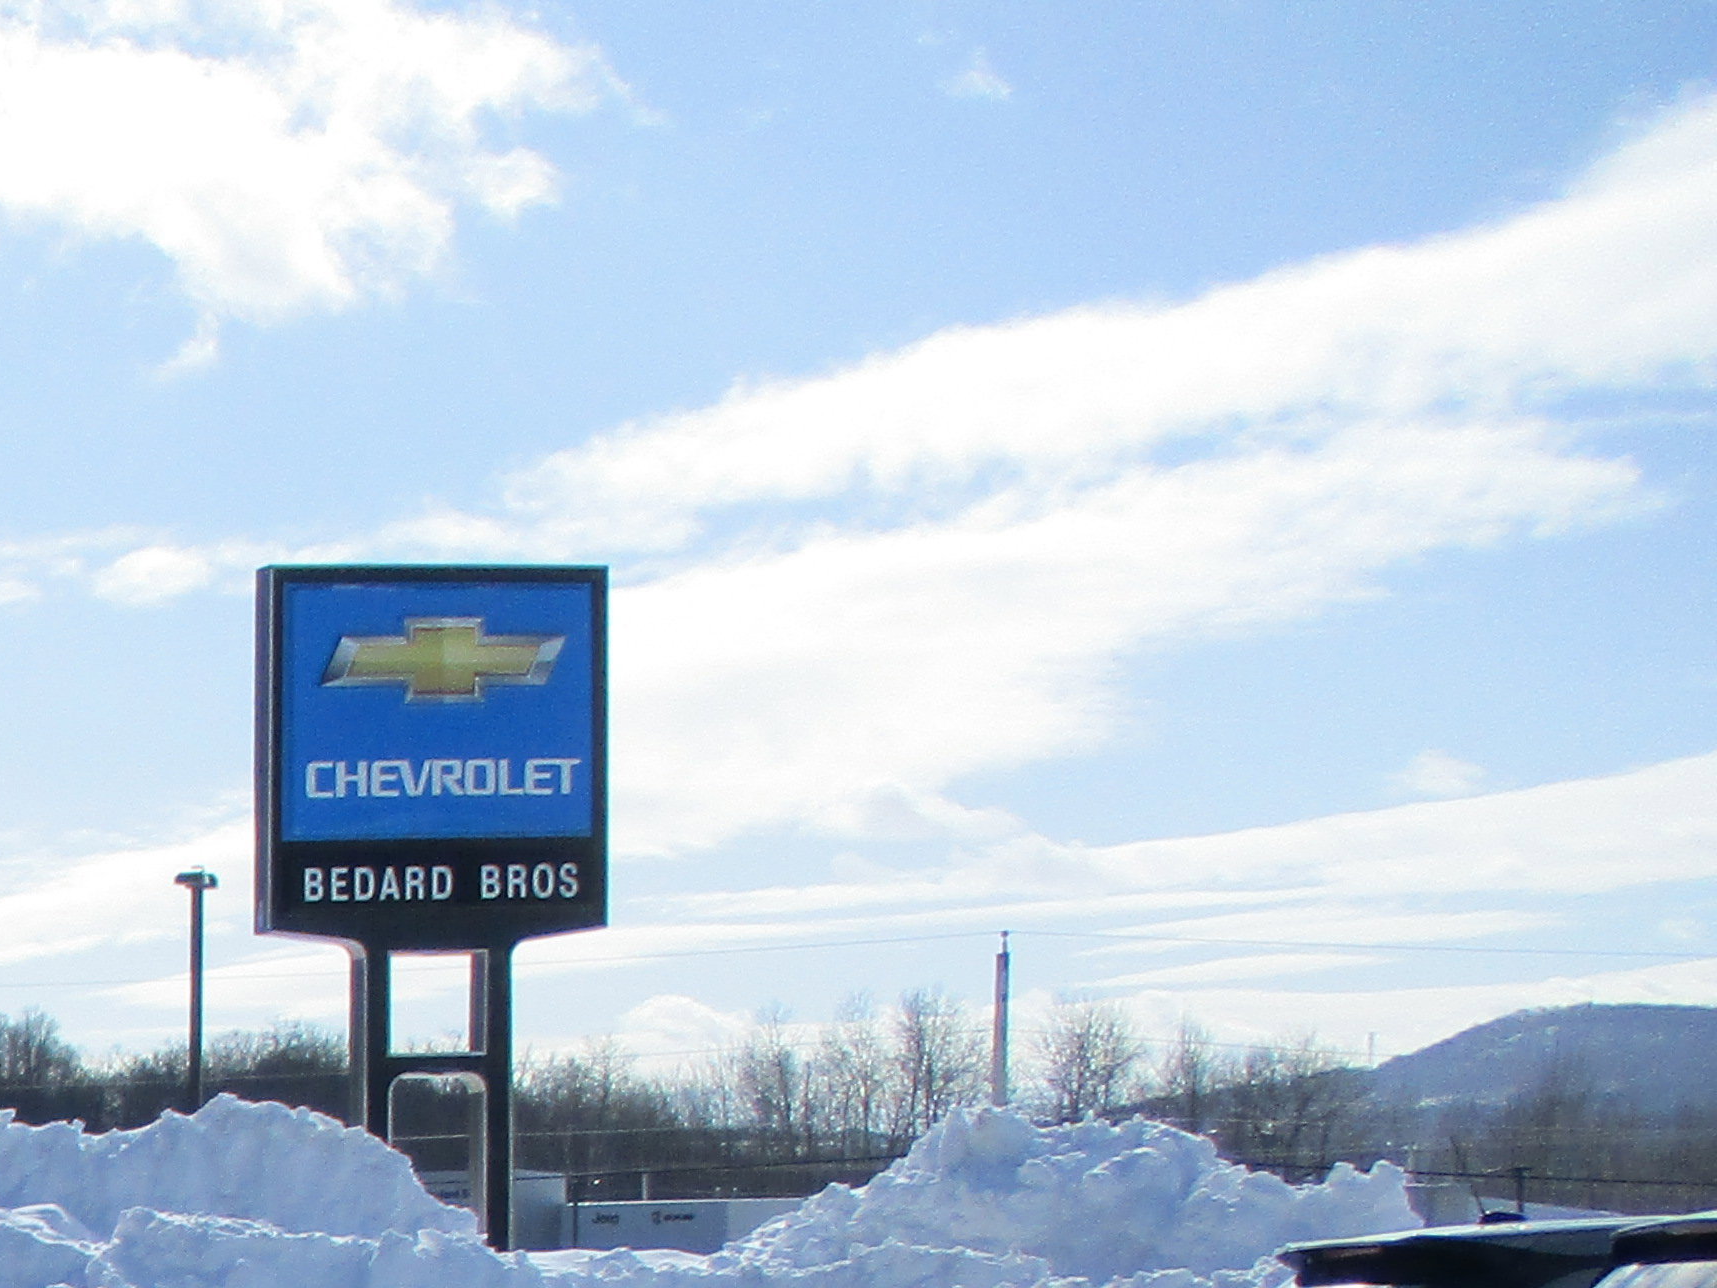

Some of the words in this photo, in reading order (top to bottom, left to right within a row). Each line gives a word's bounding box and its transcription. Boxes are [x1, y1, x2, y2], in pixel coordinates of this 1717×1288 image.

[304, 758, 582, 799] CHEVROLET
[303, 864, 454, 902] BEDARD
[479, 862, 579, 899] BROS
